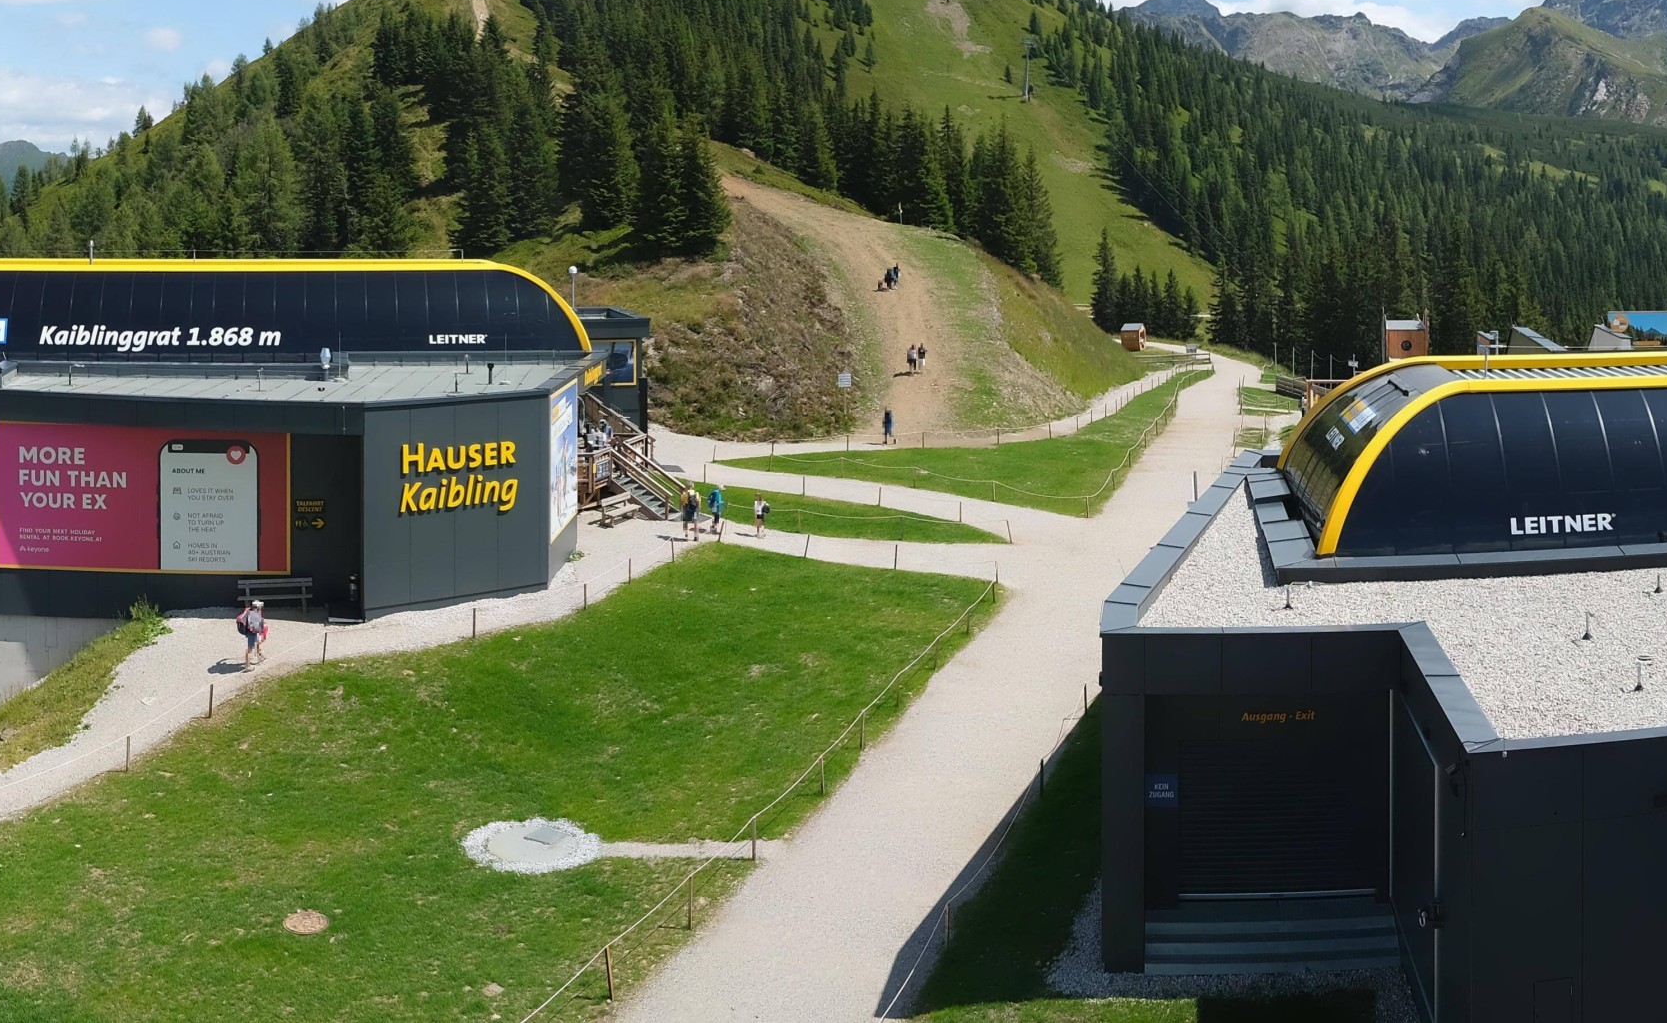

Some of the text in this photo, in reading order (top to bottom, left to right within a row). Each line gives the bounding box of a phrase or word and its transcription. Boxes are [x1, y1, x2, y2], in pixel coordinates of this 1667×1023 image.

[39, 325, 281, 352] Kaiblinggrat 1.868 m
[429, 334, 487, 344] LEITNER
[19, 446, 85, 465] MORE
[402, 441, 516, 474] HAUSER
[19, 469, 127, 488] FUN THAN
[20, 492, 107, 510] YOUR EX
[400, 474, 518, 512] Kaibling
[1510, 513, 1614, 535] LEITNER
[1241, 712, 1287, 724] Ausgang
[1296, 710, 1316, 720] Exit
